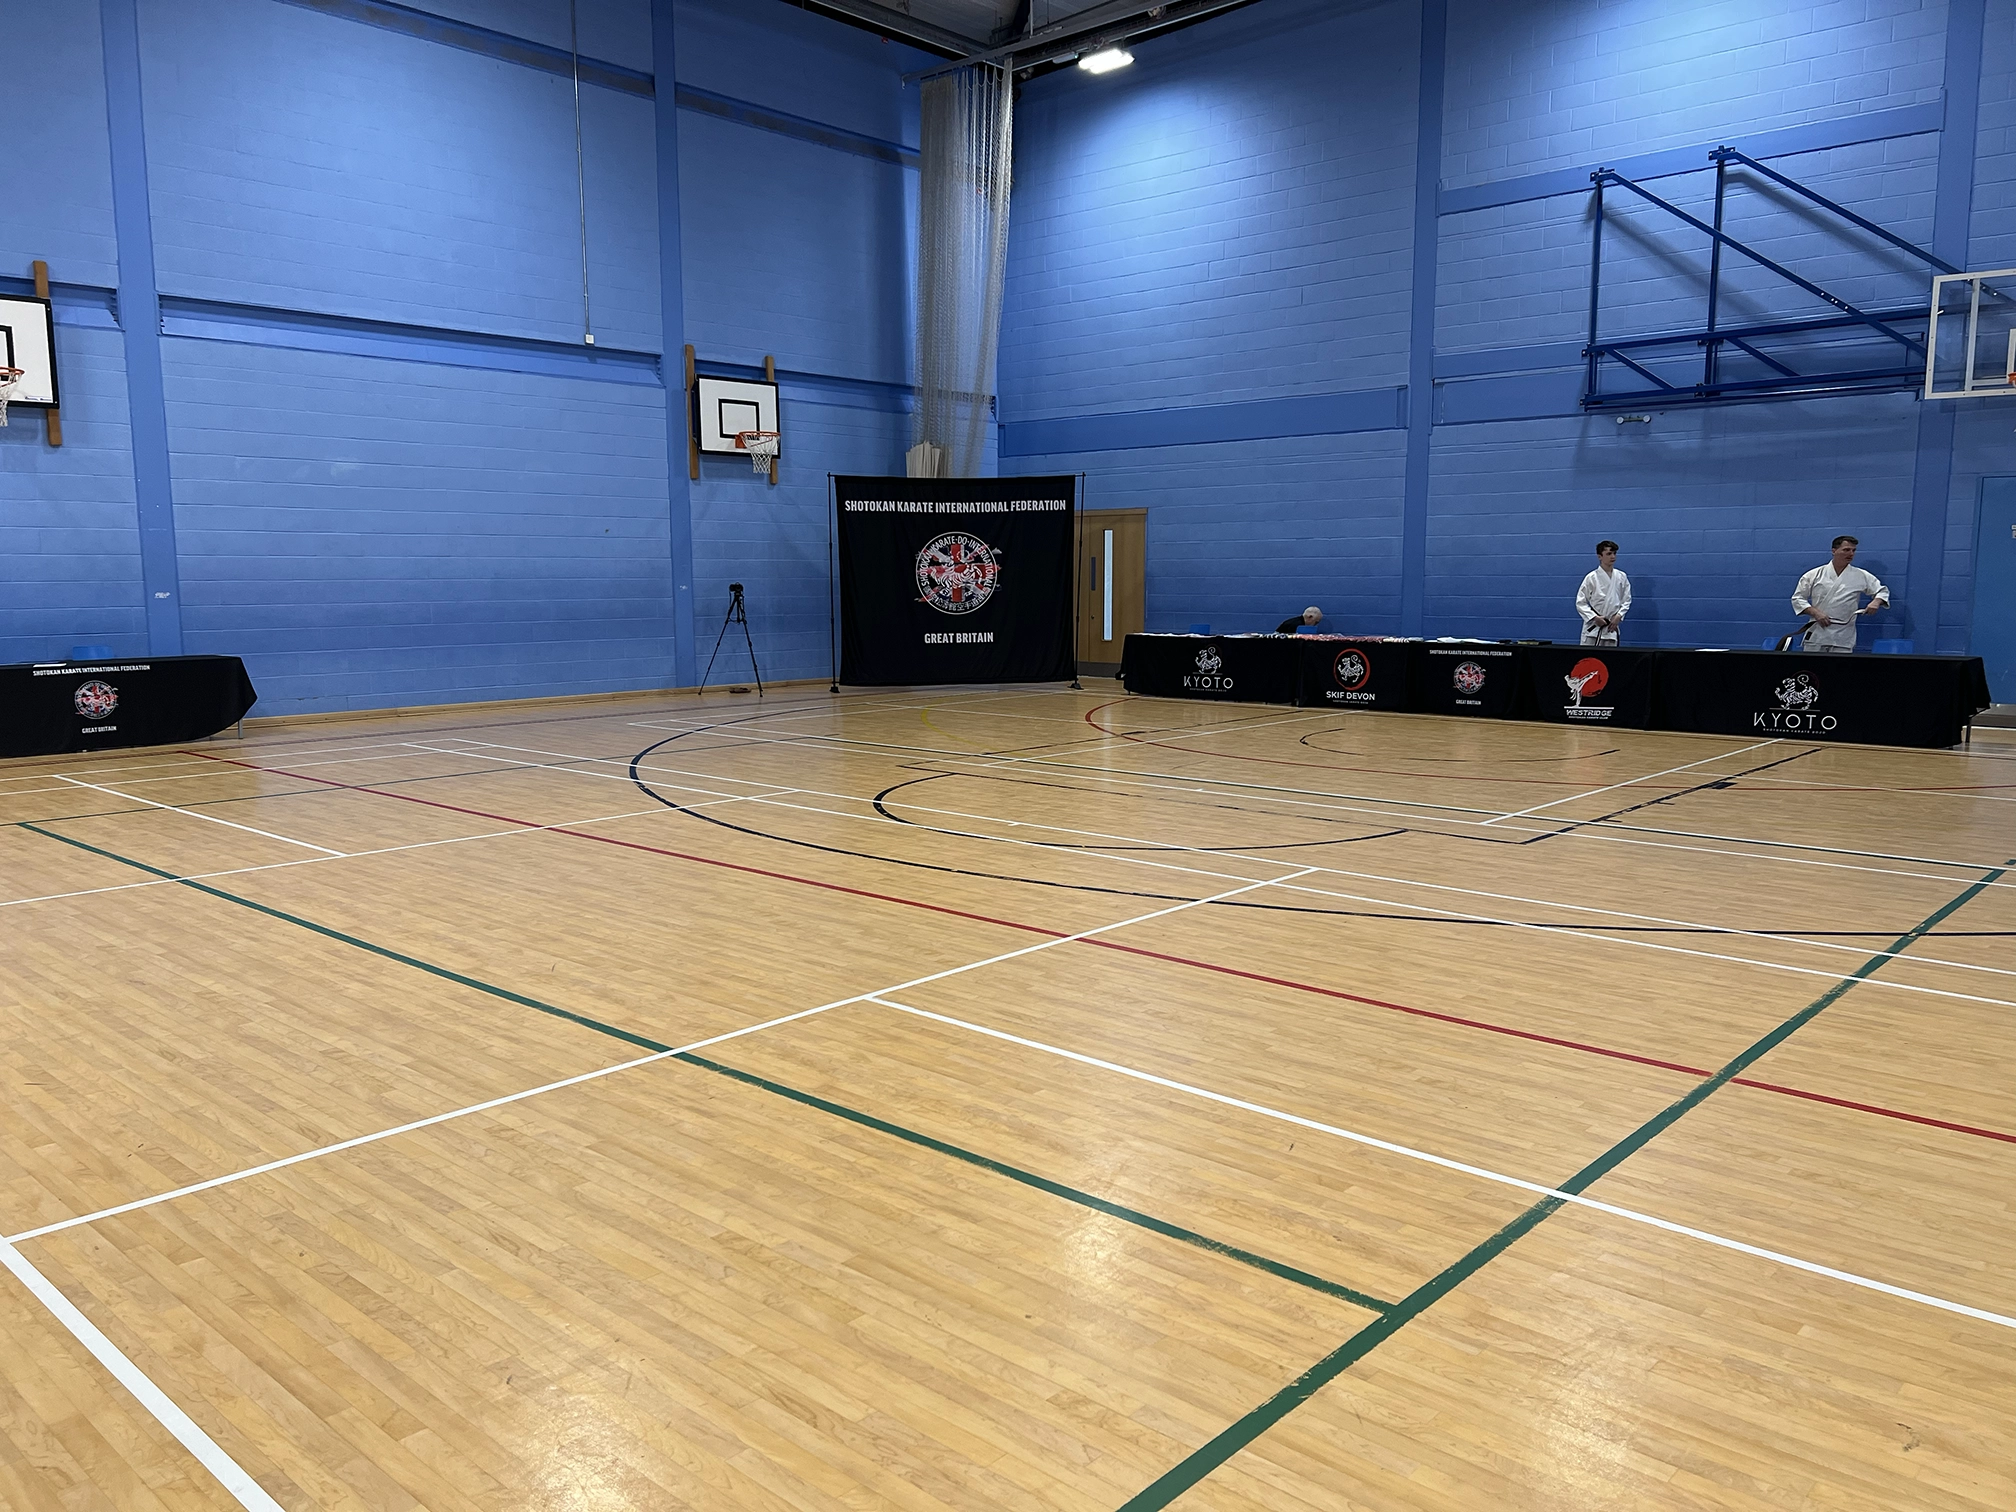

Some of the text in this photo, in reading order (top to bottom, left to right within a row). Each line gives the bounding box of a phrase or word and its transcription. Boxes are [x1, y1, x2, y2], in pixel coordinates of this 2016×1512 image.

[844, 499, 1066, 513] SHOTOKAN KARATE INTERNATIONAL FEDERATION
[924, 631, 994, 644] GREAT BRITAIN
[33, 664, 151, 677] SHOTOKAN KARATE INTERNATIONAL FEDERATION
[1183, 675, 1234, 689] KYOTO
[1325, 690, 1376, 701] SKIF DEVON
[1566, 709, 1613, 717] WESTRIDGE
[1753, 712, 1837, 730] KYOTO
